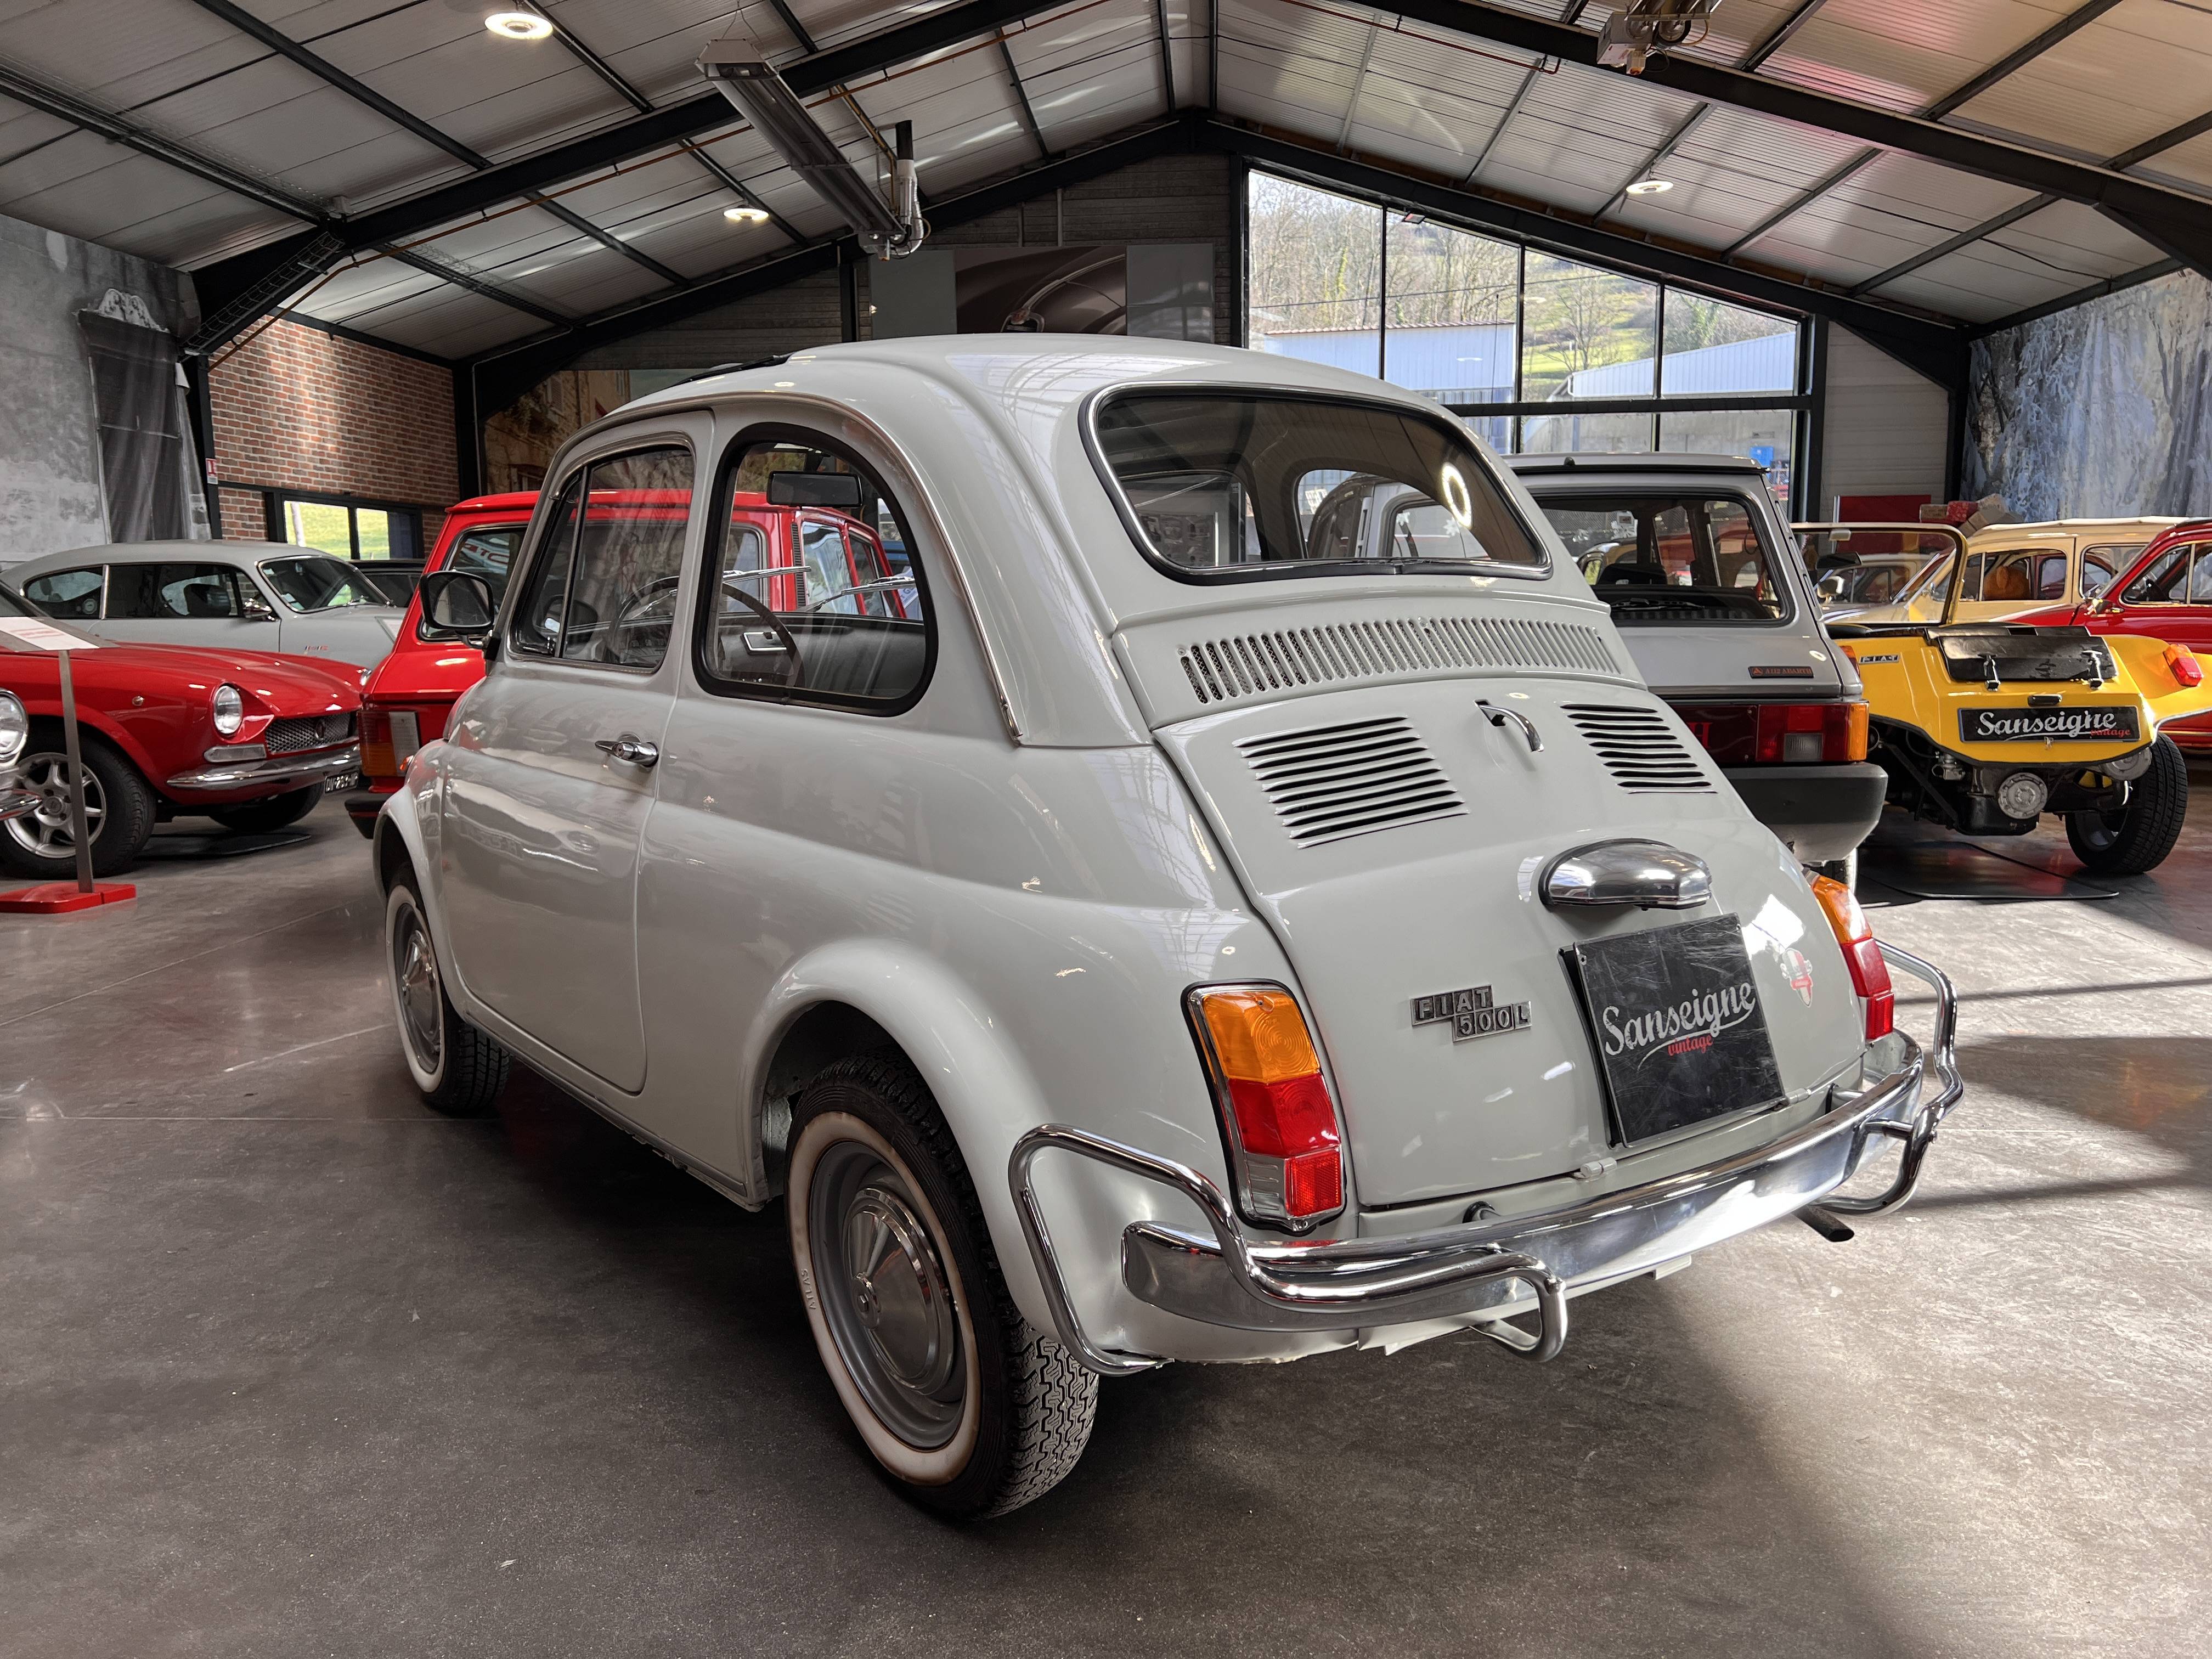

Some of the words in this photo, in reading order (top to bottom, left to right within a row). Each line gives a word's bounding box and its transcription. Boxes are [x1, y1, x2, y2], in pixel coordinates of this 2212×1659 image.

[1861, 654, 1898, 663] FIAT
[1977, 710, 2117, 738] Sanseigne
[1418, 988, 1489, 1019] FIAT
[1459, 1005, 1528, 1035] 500L
[1602, 982, 1756, 1056] Sanseigne
[1667, 1034, 1714, 1057] vintage
[801, 1268, 817, 1310] ATLAS
